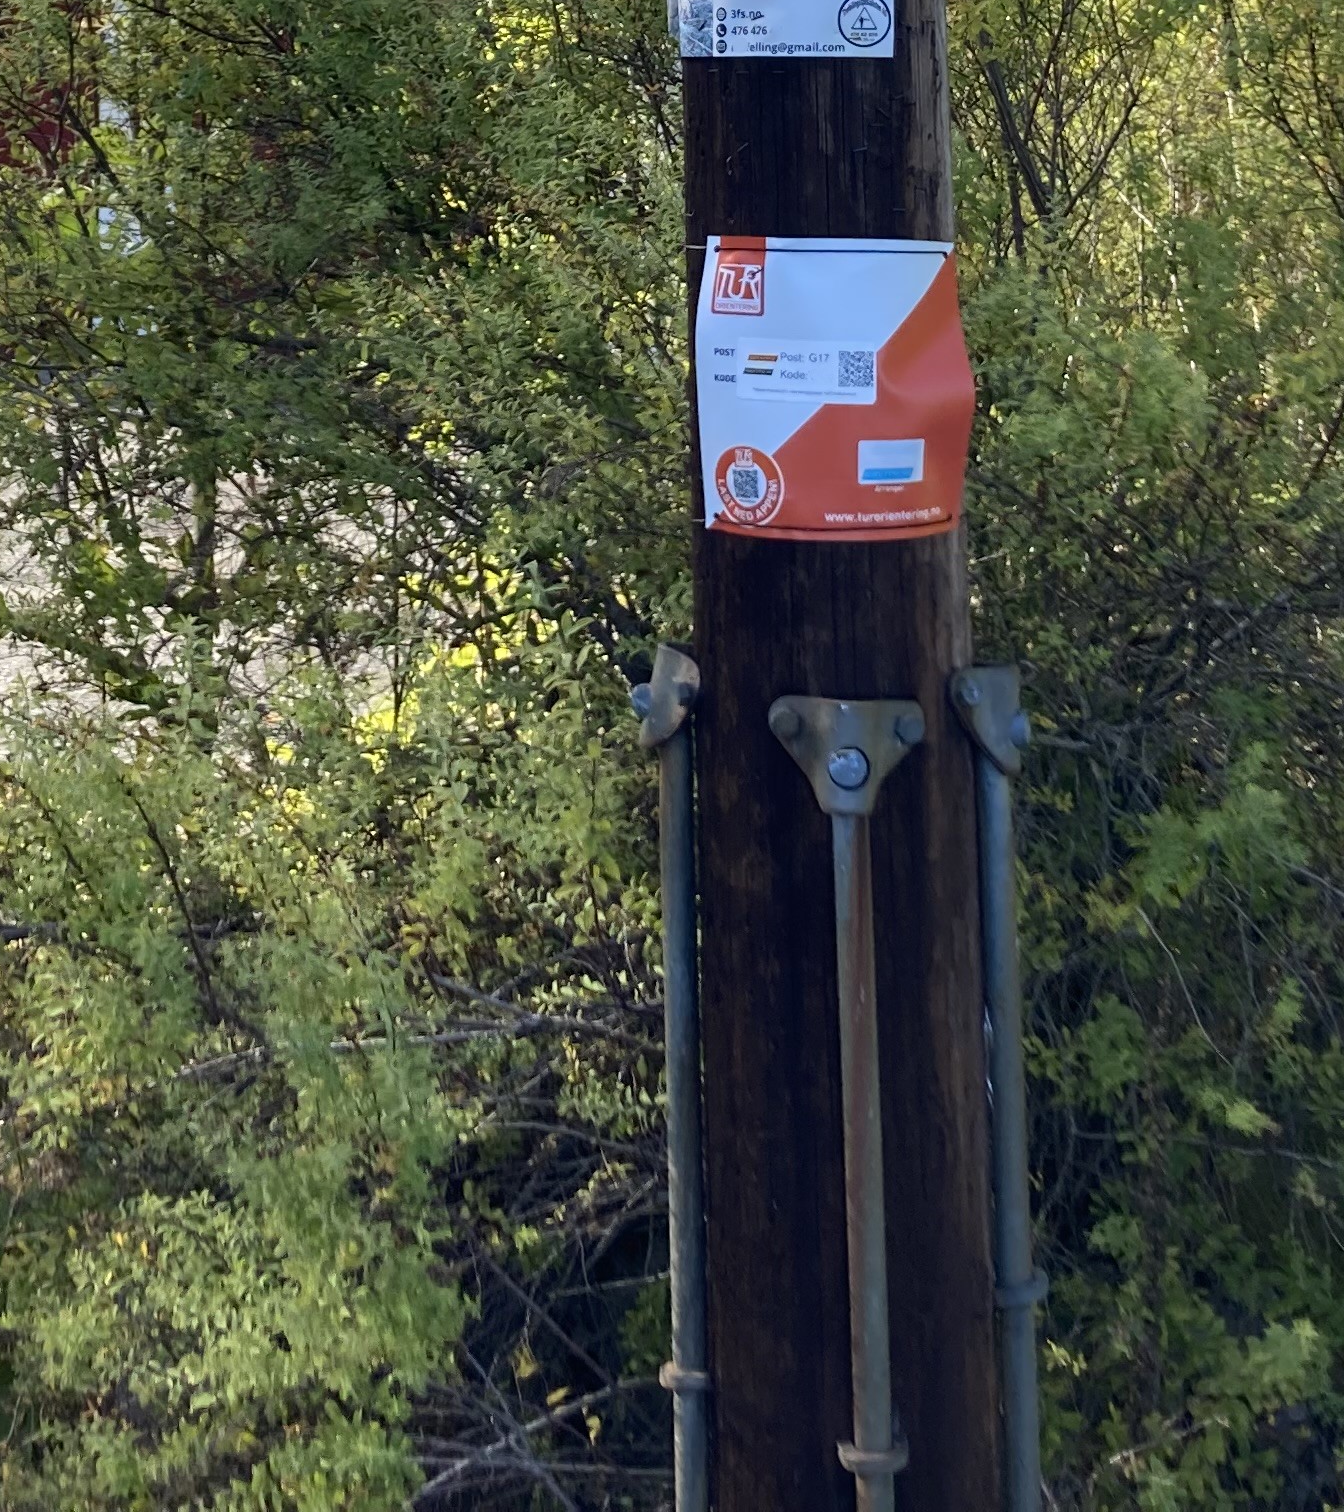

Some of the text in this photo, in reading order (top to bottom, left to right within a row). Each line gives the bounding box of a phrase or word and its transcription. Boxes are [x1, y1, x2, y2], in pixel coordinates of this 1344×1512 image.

[731, 26, 748, 35] 476
[714, 348, 735, 356] POST
[780, 352, 805, 362] Post:
[809, 353, 830, 362] G17
[714, 374, 736, 383] KODE
[780, 370, 808, 379] Kode:
